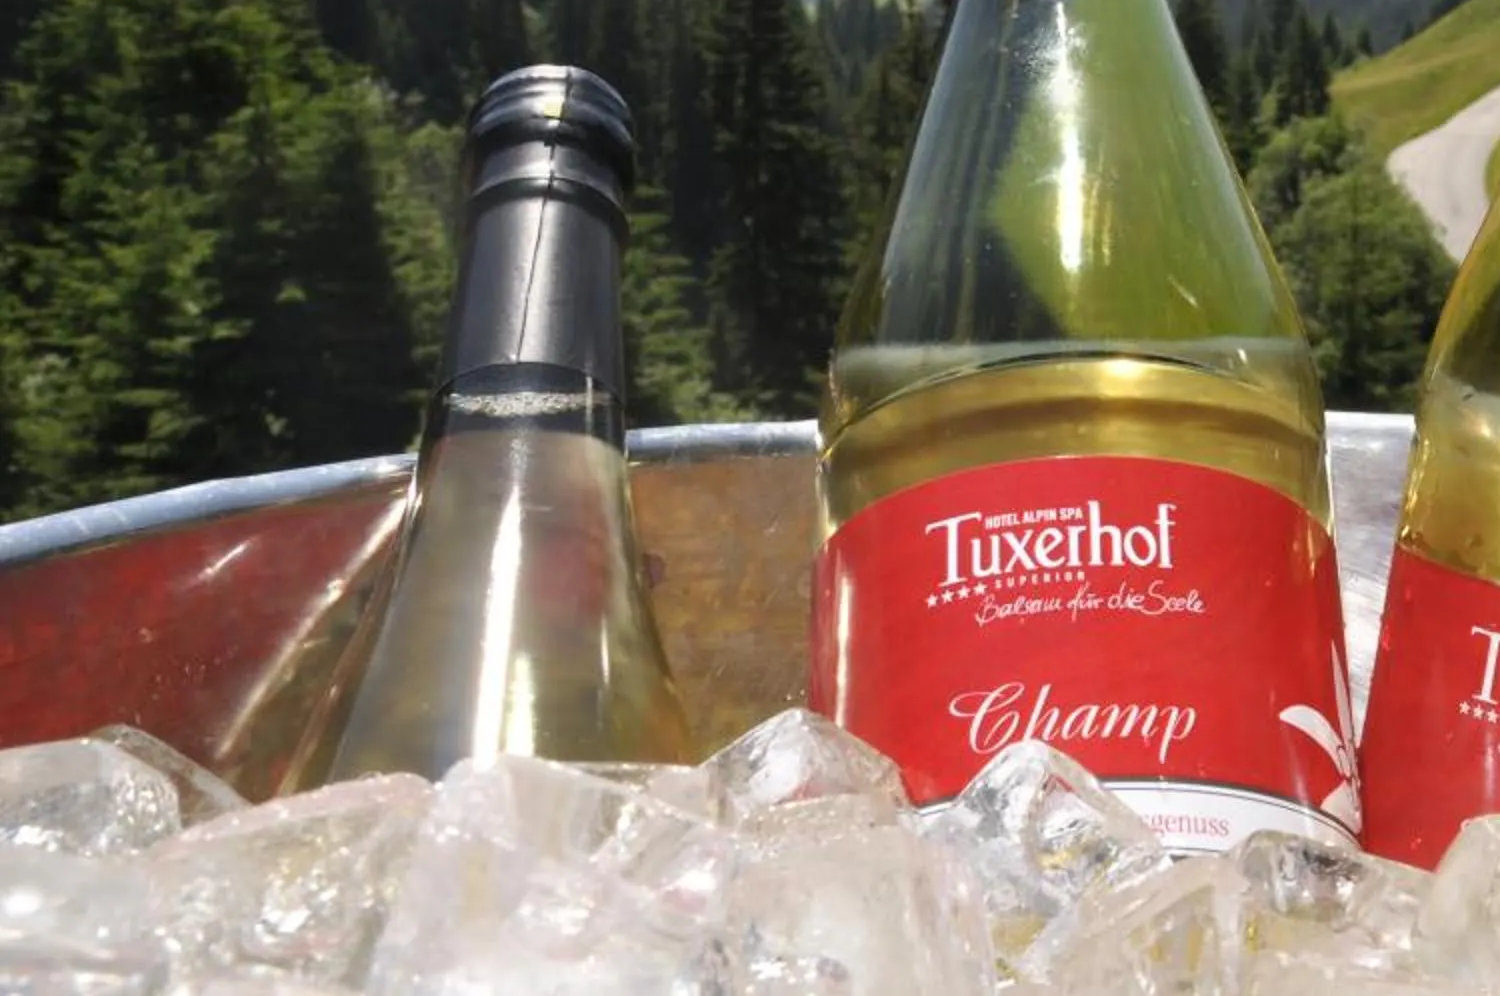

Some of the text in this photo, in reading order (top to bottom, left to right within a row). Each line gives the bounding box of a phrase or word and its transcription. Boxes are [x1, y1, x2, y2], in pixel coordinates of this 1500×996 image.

[925, 500, 1177, 587] Tuxerhof
[985, 507, 1084, 529] HOTEL ALPIN SPA
[1108, 581, 1144, 611] die
[948, 681, 1197, 764] Champ
